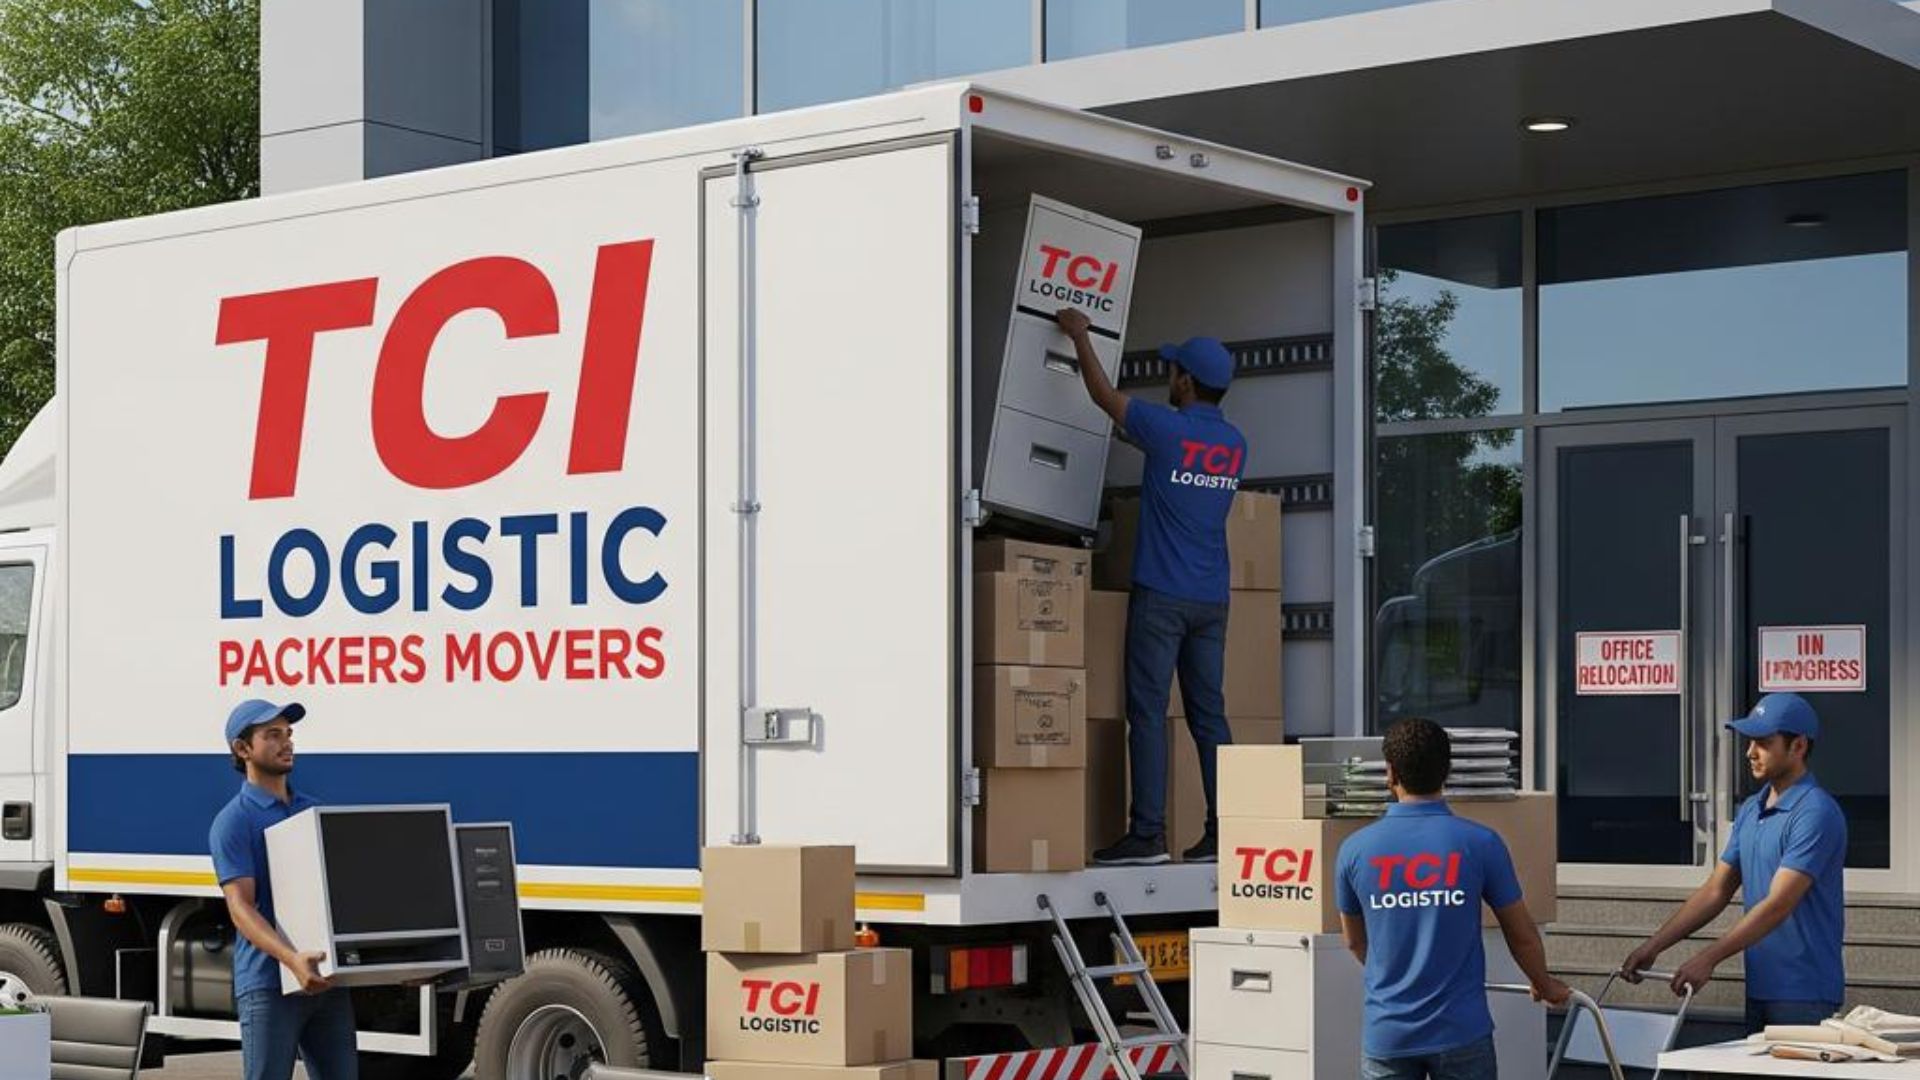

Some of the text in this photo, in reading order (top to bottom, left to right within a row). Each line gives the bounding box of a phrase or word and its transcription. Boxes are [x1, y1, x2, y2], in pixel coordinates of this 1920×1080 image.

[1039, 245, 1119, 293] TCI
[1030, 279, 1114, 312] LOGISTIC
[215, 238, 655, 500] TCI
[1181, 439, 1243, 475] TCI
[1171, 470, 1240, 490] LOGISTIC
[219, 506, 668, 619] LOGISTIC
[219, 627, 666, 687] PACKERS MOVERS
[1601, 639, 1654, 661] OFFICE
[1580, 663, 1675, 685] RELOCATION
[1235, 846, 1313, 884] TCI
[1369, 852, 1461, 889] TCI
[1231, 883, 1314, 902] LOGISTIC
[1370, 889, 1465, 910] LOGISTIC
[740, 979, 821, 1016] TCI
[740, 1016, 820, 1034] LOGISTIC
